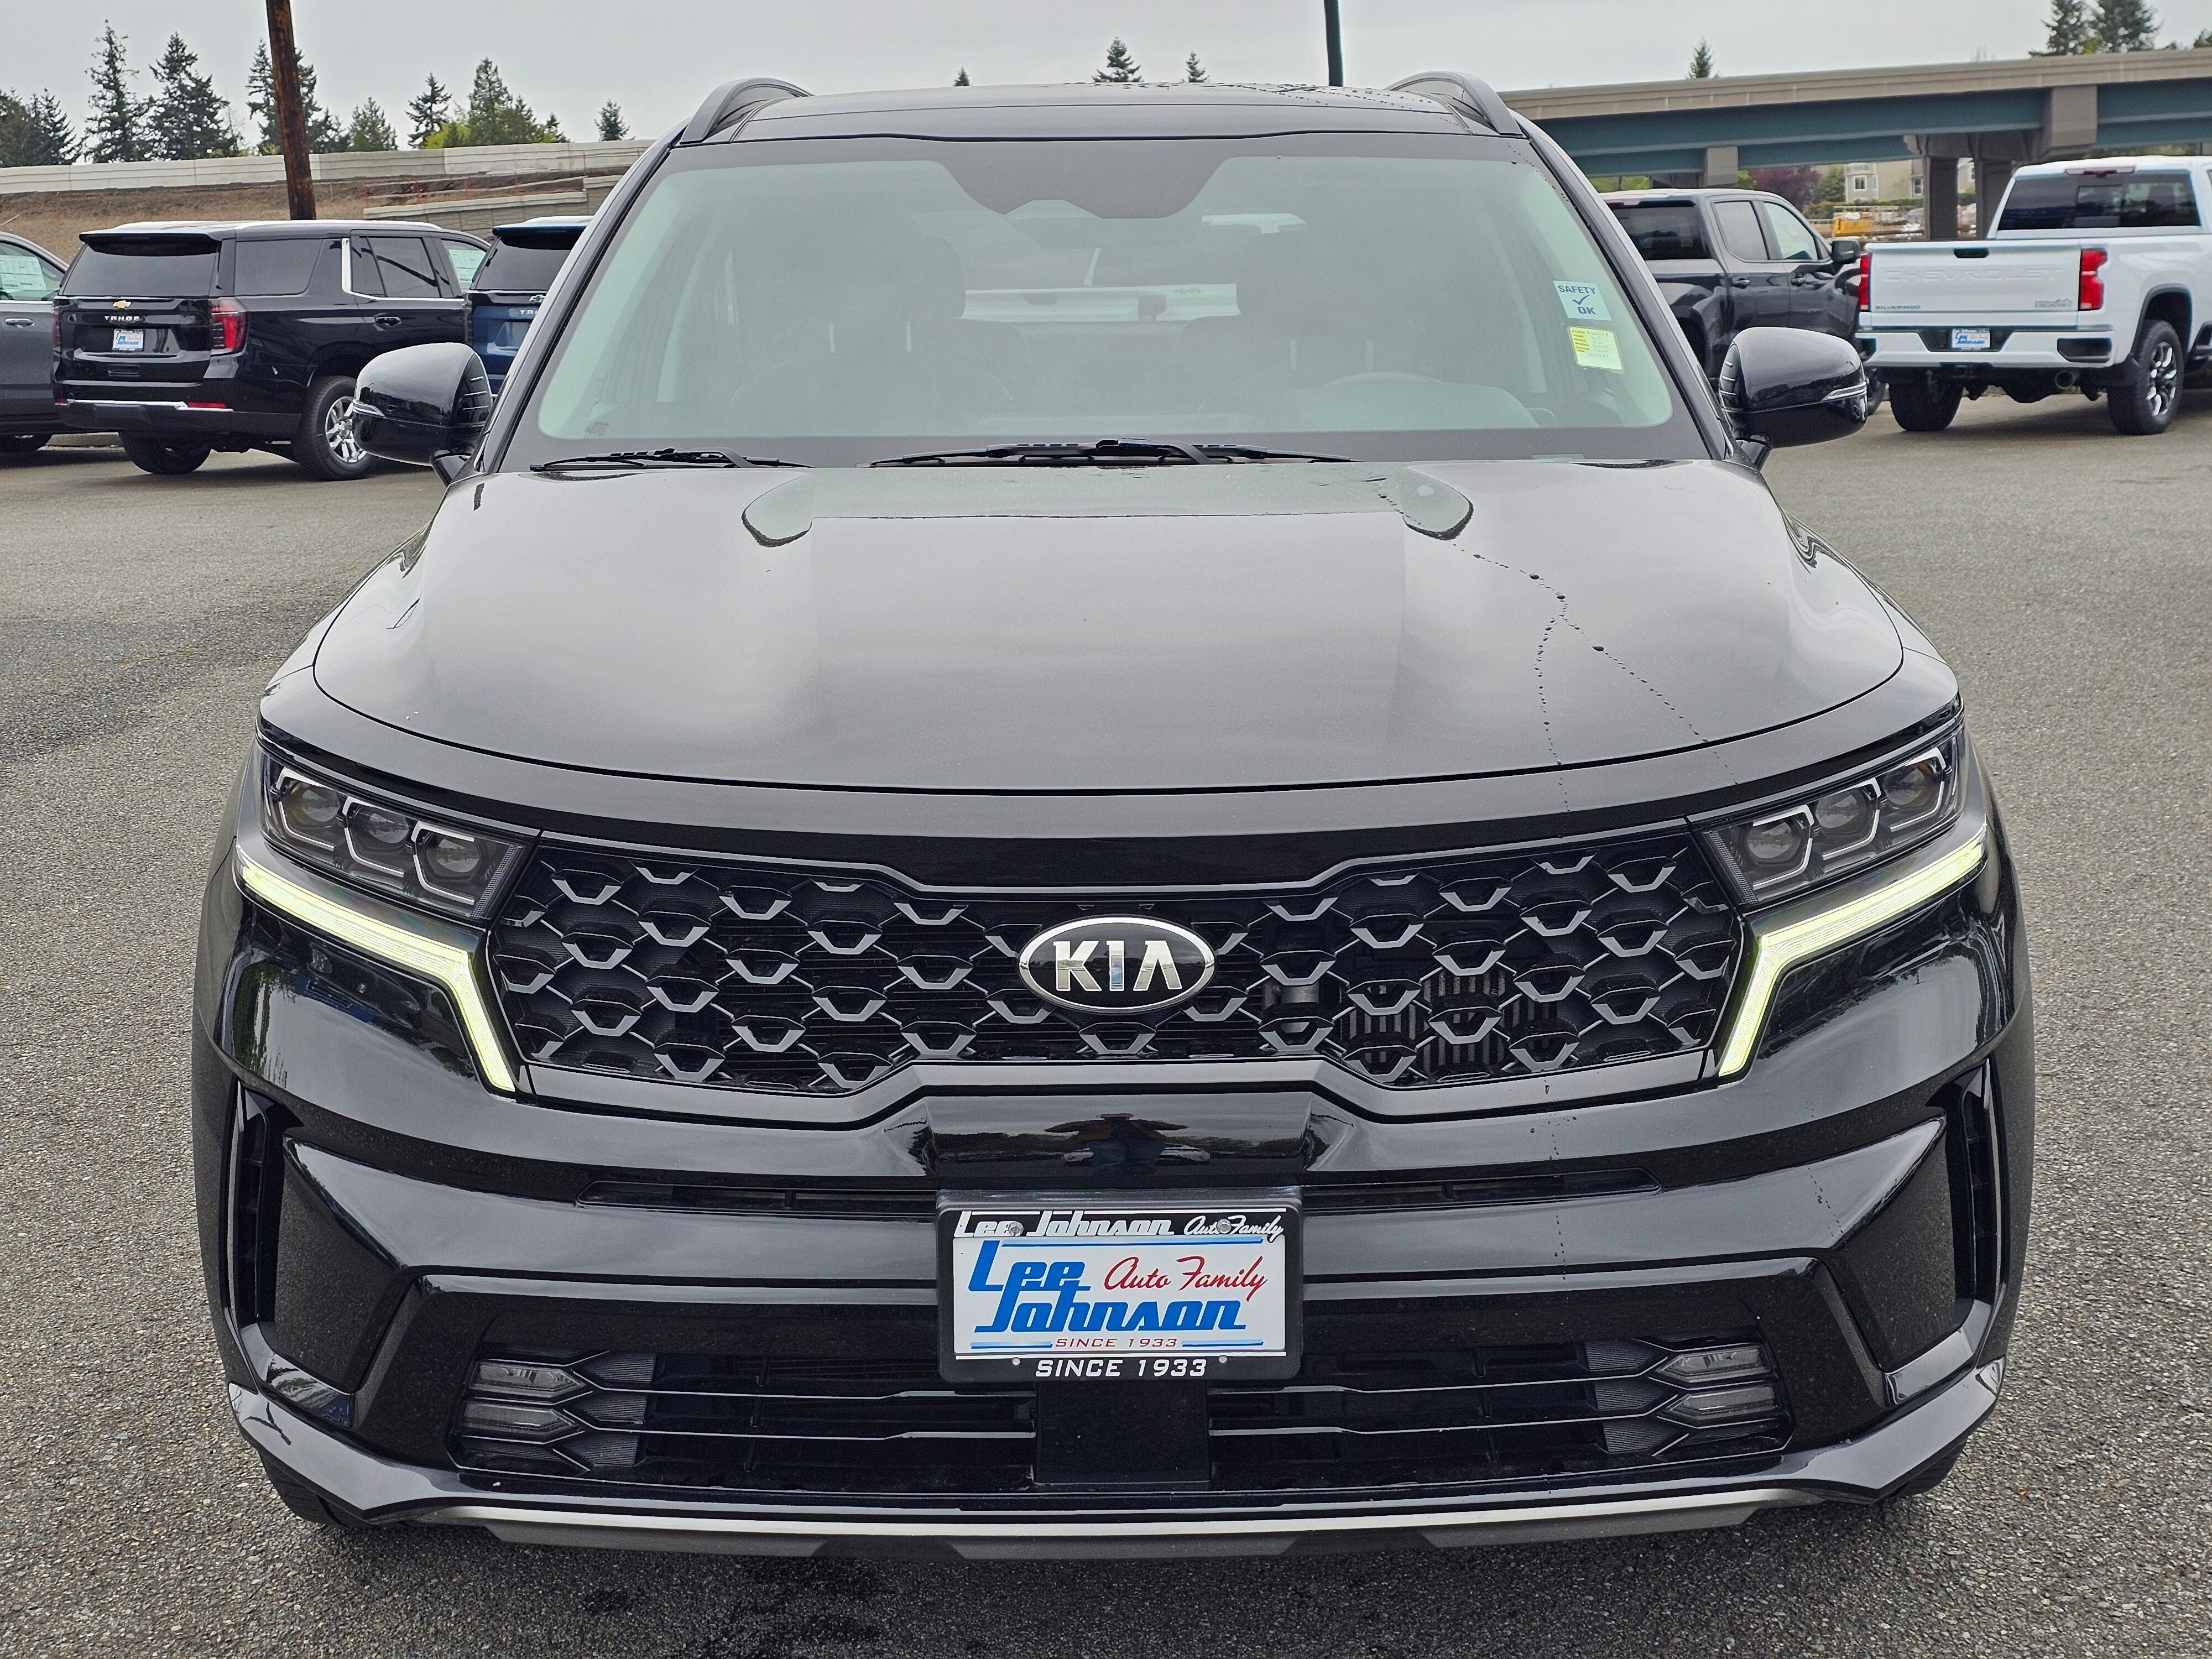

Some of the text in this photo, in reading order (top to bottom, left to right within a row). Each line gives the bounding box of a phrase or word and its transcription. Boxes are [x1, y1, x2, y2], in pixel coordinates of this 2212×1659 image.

[1885, 268, 2063, 281] CHEVROLET
[1558, 285, 1595, 294] SAFETY
[1578, 306, 1597, 315] OK
[1053, 940, 1182, 992] KIA
[1026, 1210, 1173, 1237] Johnson
[1228, 1215, 1284, 1243] Family
[968, 1240, 1091, 1294] Lee
[1104, 1256, 1268, 1302] Auto Family
[974, 1286, 1246, 1332] Johnson
[1055, 1338, 1178, 1348] SINCE 1933
[1035, 1359, 1207, 1378] SINCE 1933
